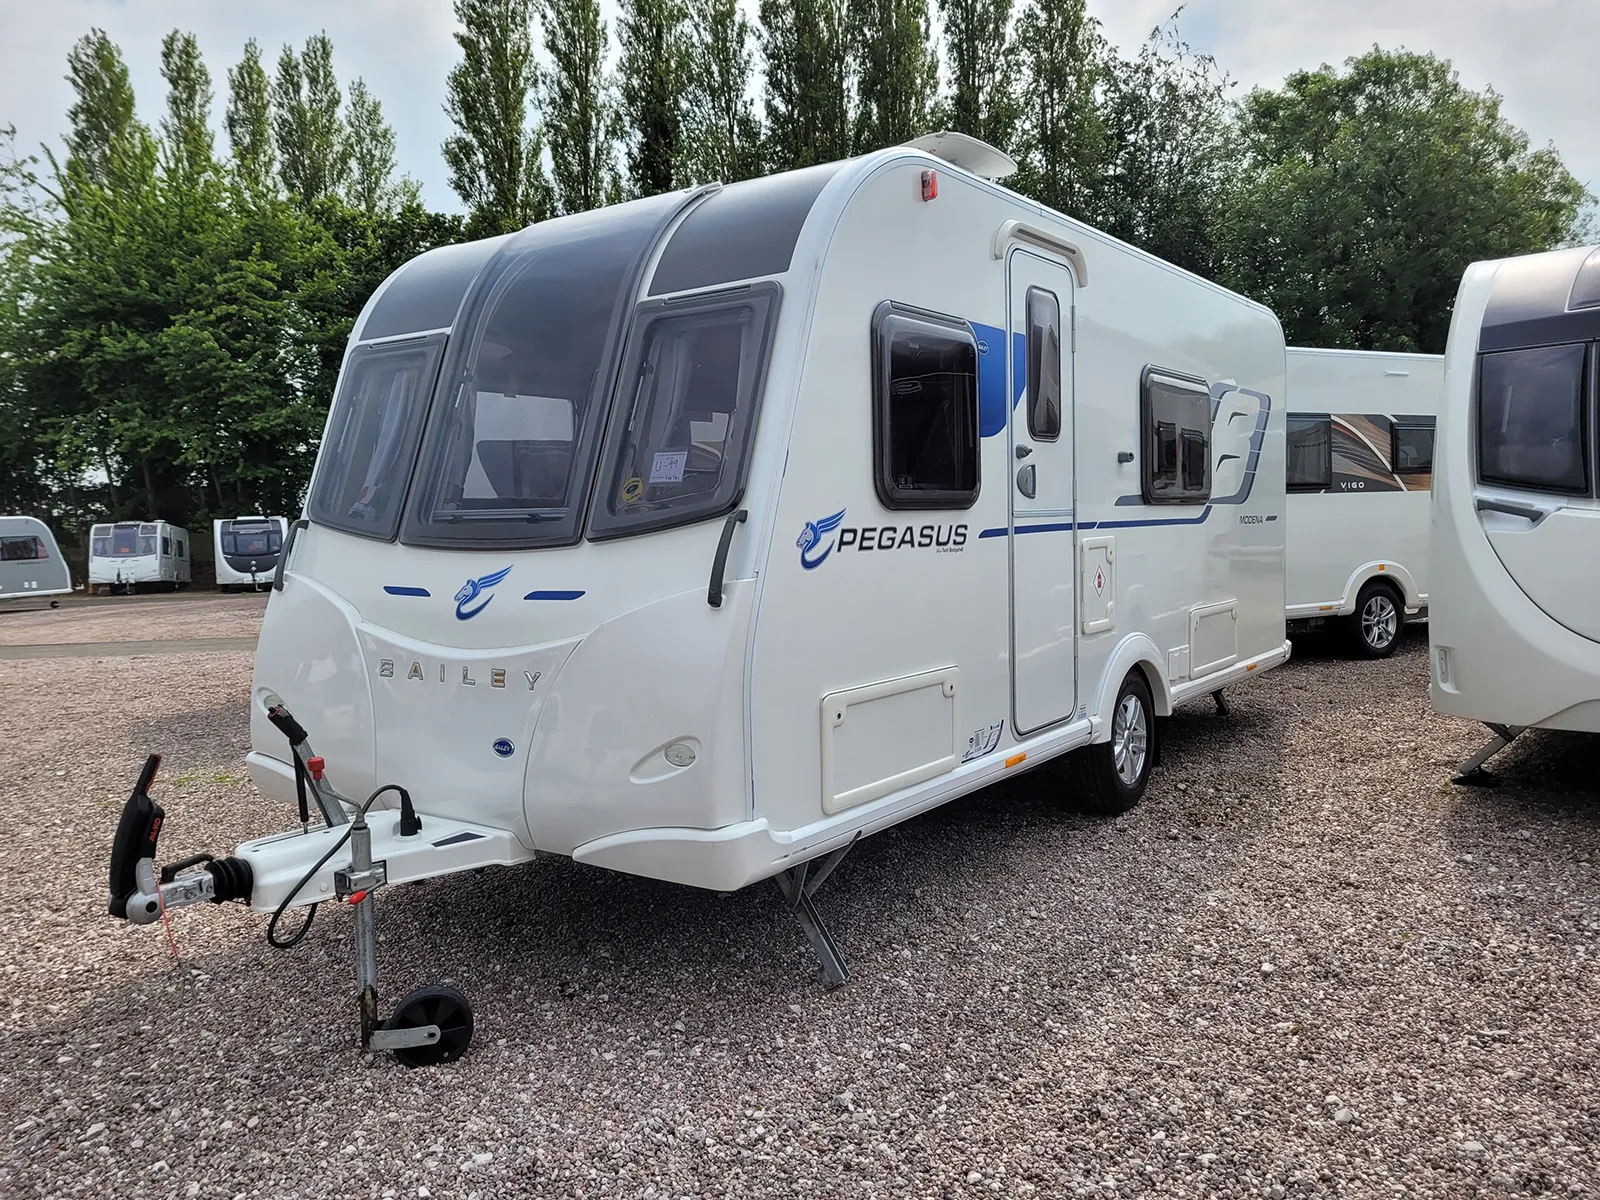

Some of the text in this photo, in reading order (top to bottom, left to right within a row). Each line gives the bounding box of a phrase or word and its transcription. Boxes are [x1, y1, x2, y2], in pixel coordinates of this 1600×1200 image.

[1340, 481, 1365, 489] VIGO
[1239, 515, 1264, 524] MODENA
[836, 524, 968, 553] PEGASUS
[380, 658, 541, 691] BAILEY
